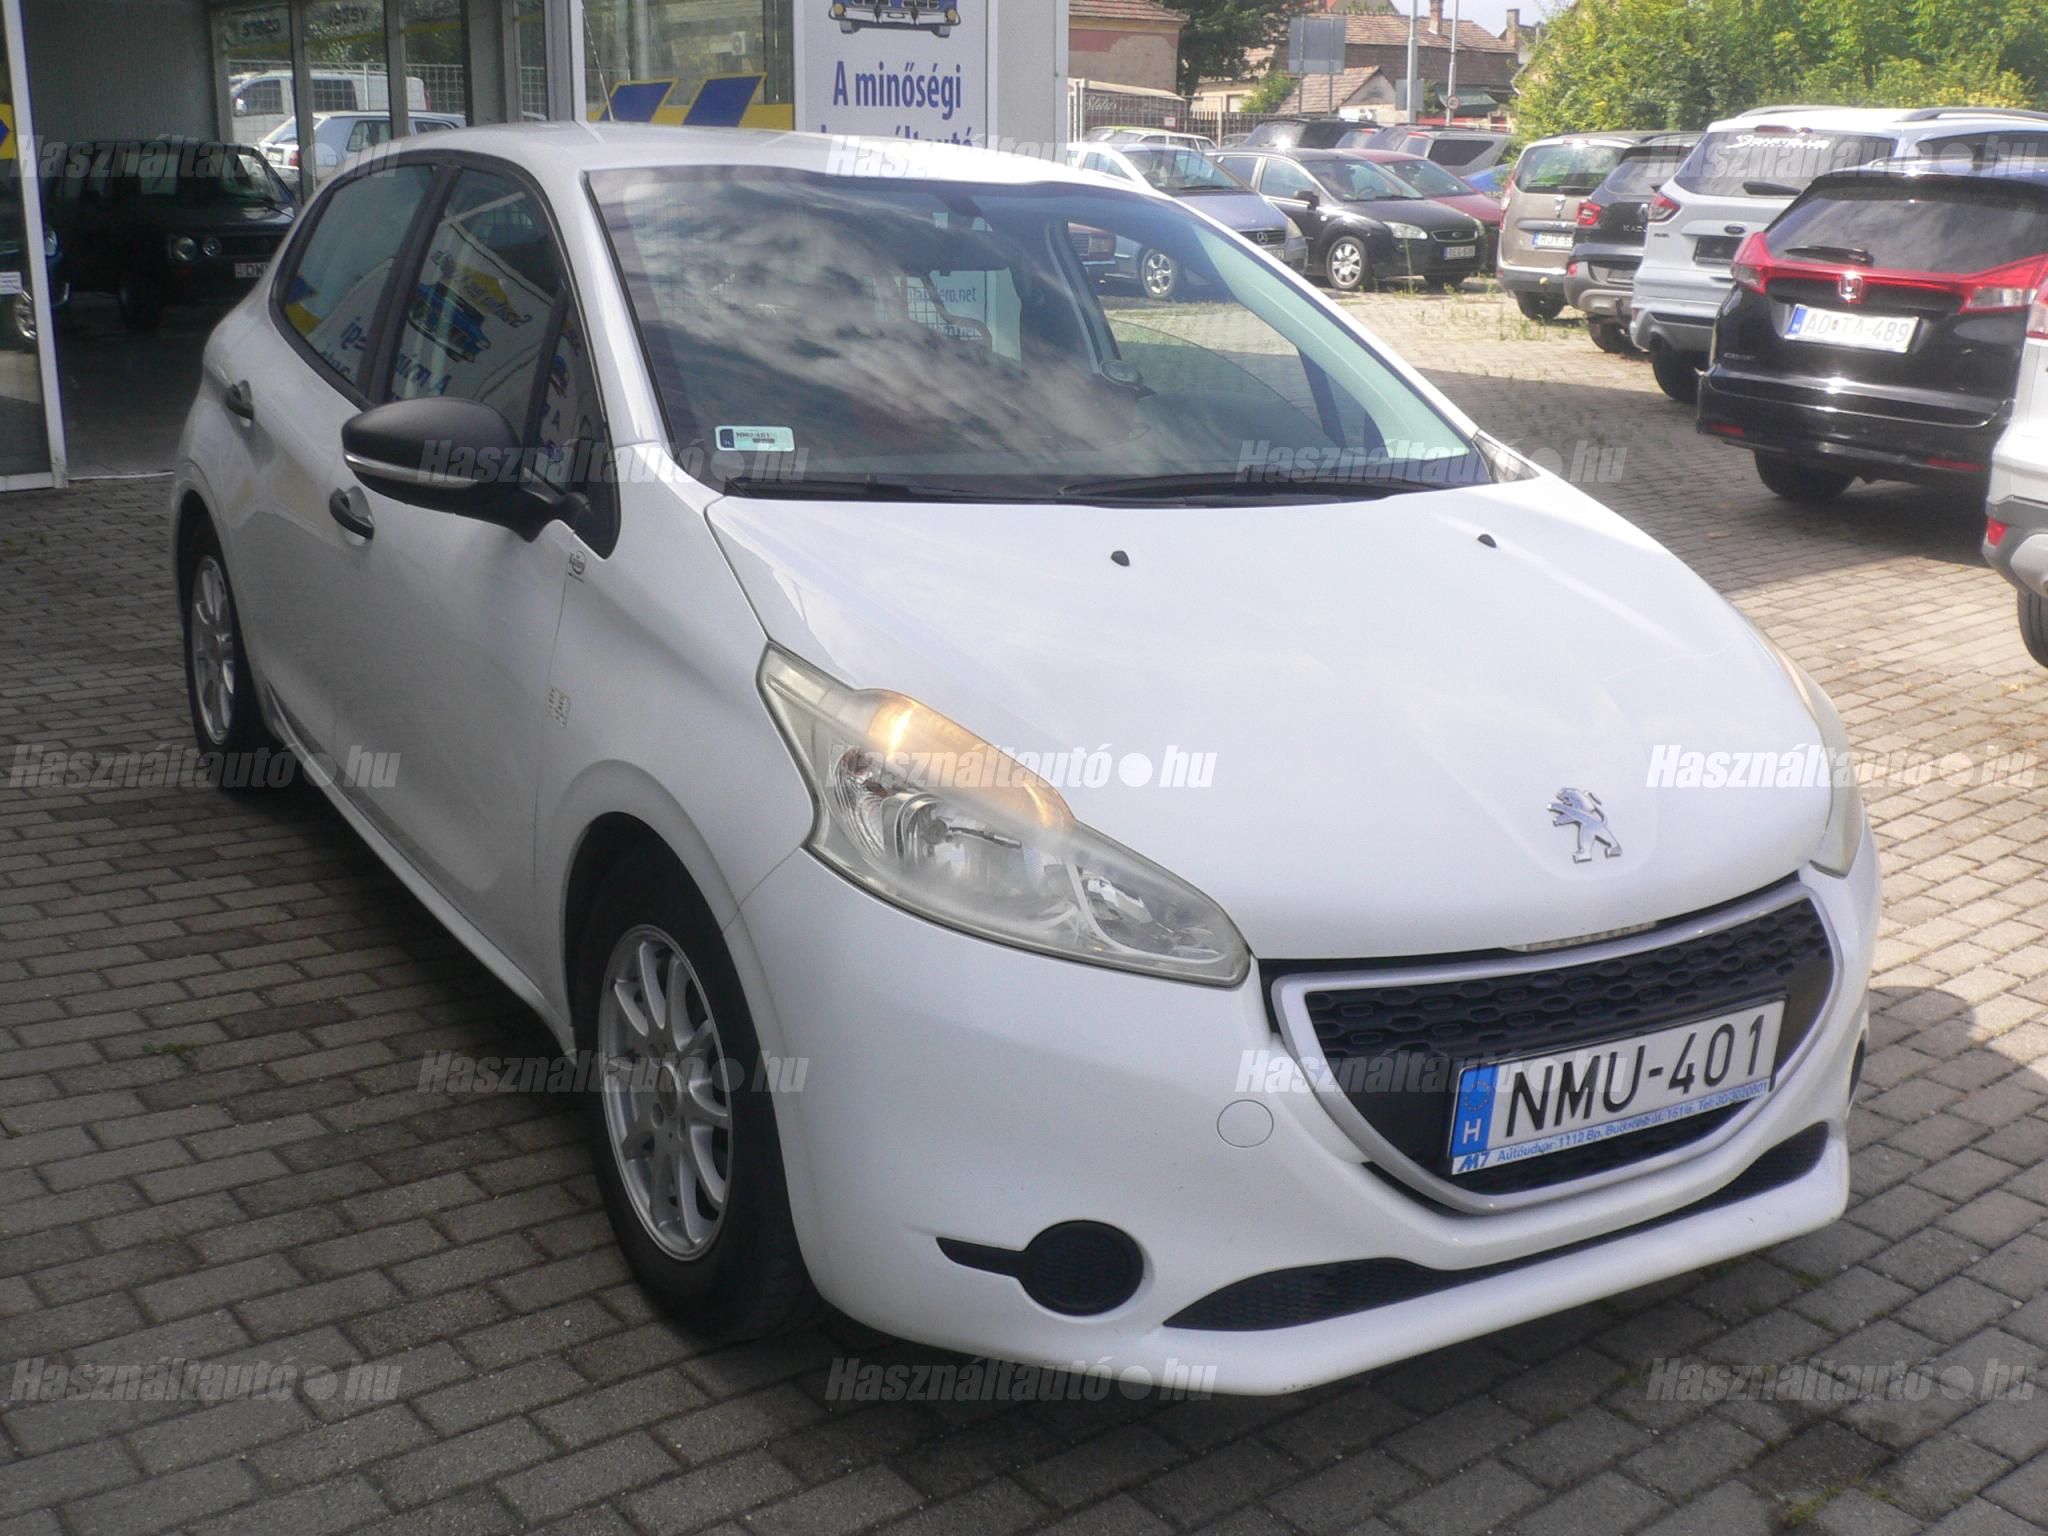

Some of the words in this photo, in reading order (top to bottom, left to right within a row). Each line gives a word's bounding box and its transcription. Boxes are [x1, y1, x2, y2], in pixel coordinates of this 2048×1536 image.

[833, 61, 849, 106] A
[855, 62, 961, 120] minőségi
[1506, 1014, 1765, 1137] NMU-401
[1462, 1118, 1482, 1145] H
[1559, 1132, 1585, 1148] 1112
